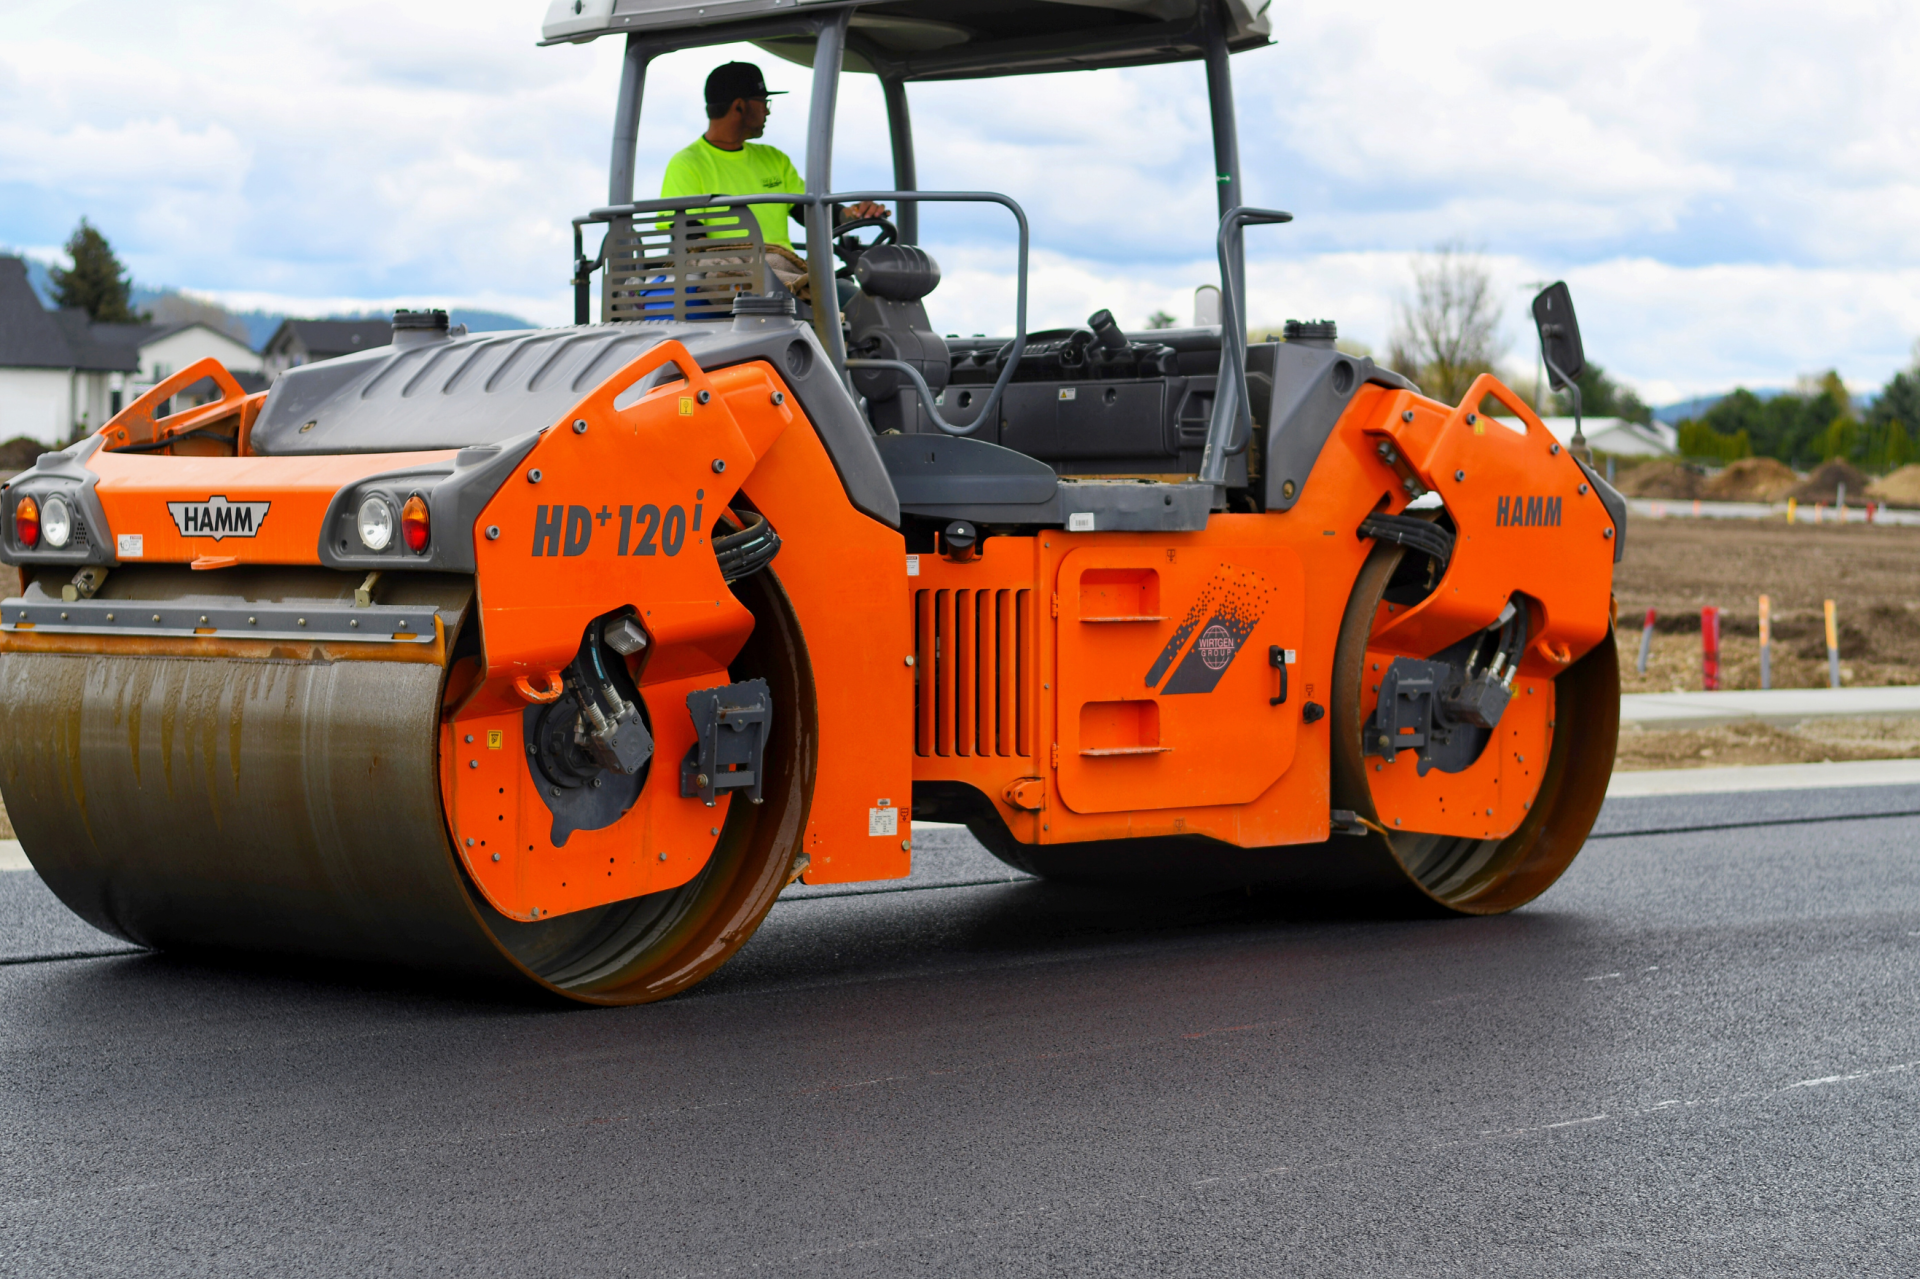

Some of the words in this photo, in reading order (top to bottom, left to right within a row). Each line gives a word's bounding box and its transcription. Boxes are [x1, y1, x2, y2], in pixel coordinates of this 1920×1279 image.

[184, 506, 253, 532] HAMM
[1496, 495, 1562, 527] HAMM
[1199, 638, 1234, 648] WIRTGEN
[1201, 649, 1231, 657] GROUP
